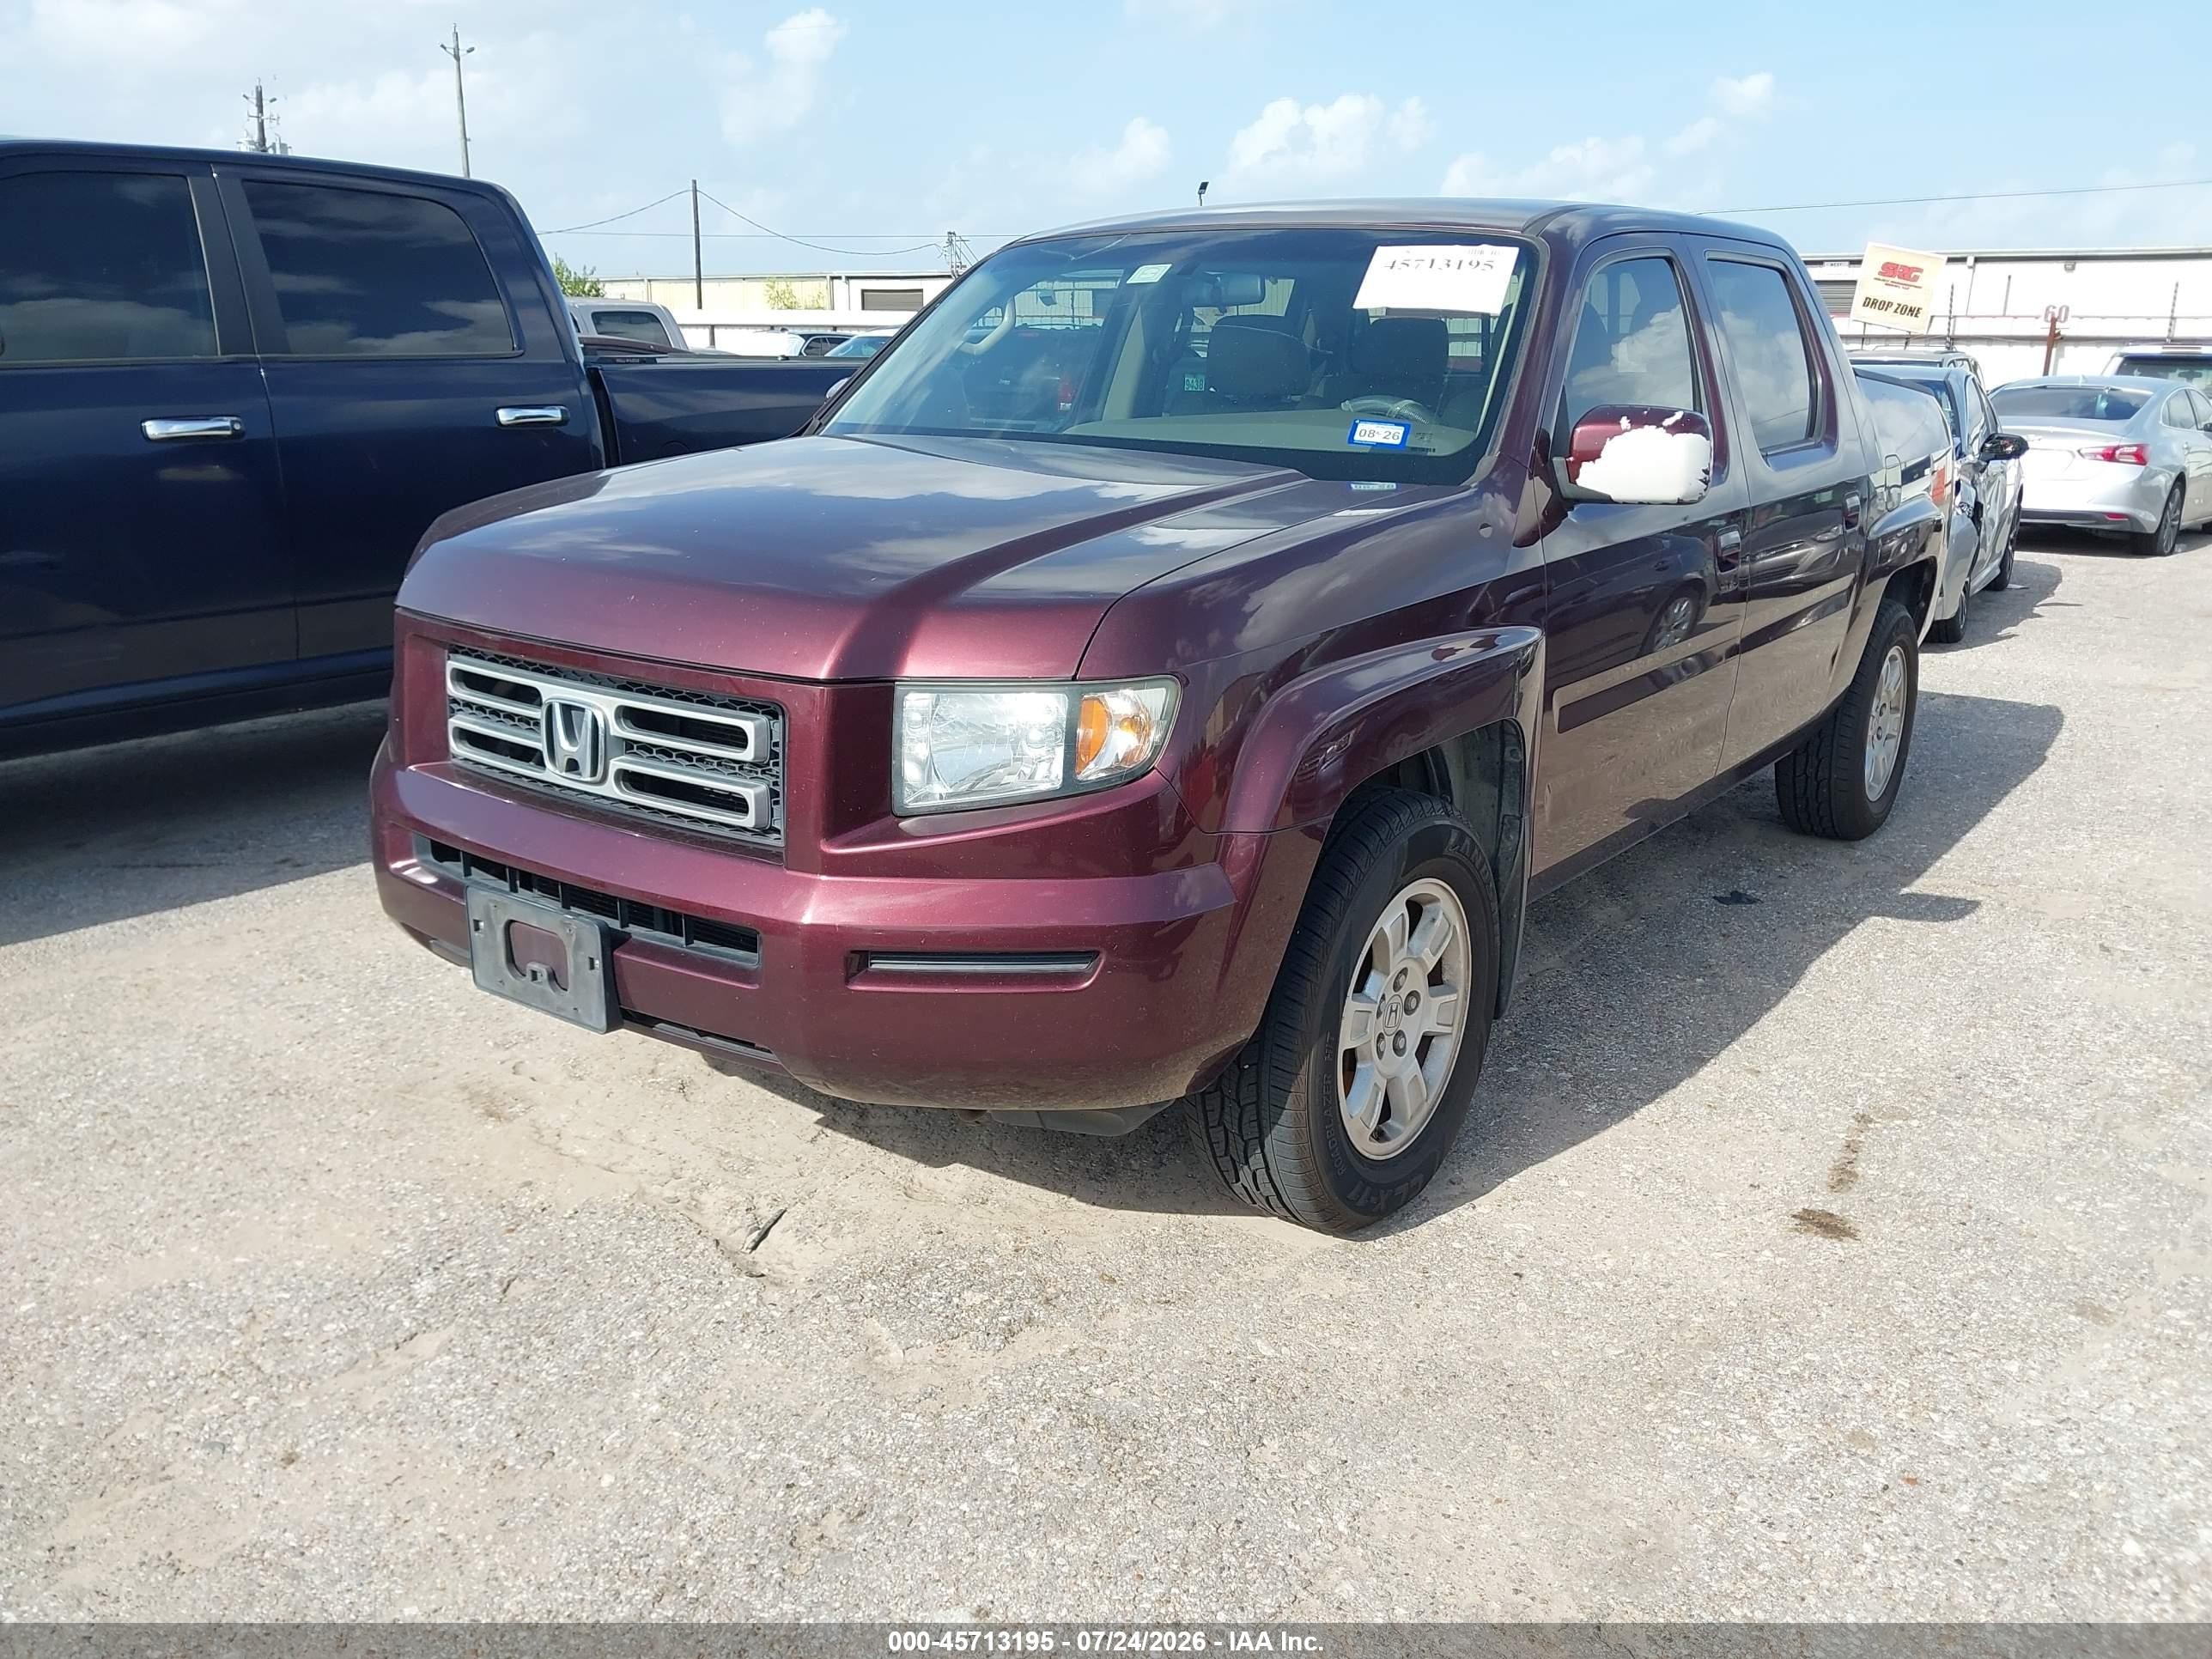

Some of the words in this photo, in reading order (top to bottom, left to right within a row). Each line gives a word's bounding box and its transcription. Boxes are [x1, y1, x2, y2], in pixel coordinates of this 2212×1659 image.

[1384, 258, 1495, 271] 45713195
[1878, 262, 1923, 283] SRG
[1863, 296, 1893, 312] DROP
[1893, 303, 1923, 319] ZONE
[2044, 304, 2069, 324] 60
[1359, 428, 1376, 438] 08
[1382, 430, 1401, 441] 26
[1322, 1074, 1346, 1176] ROADBLAZER
